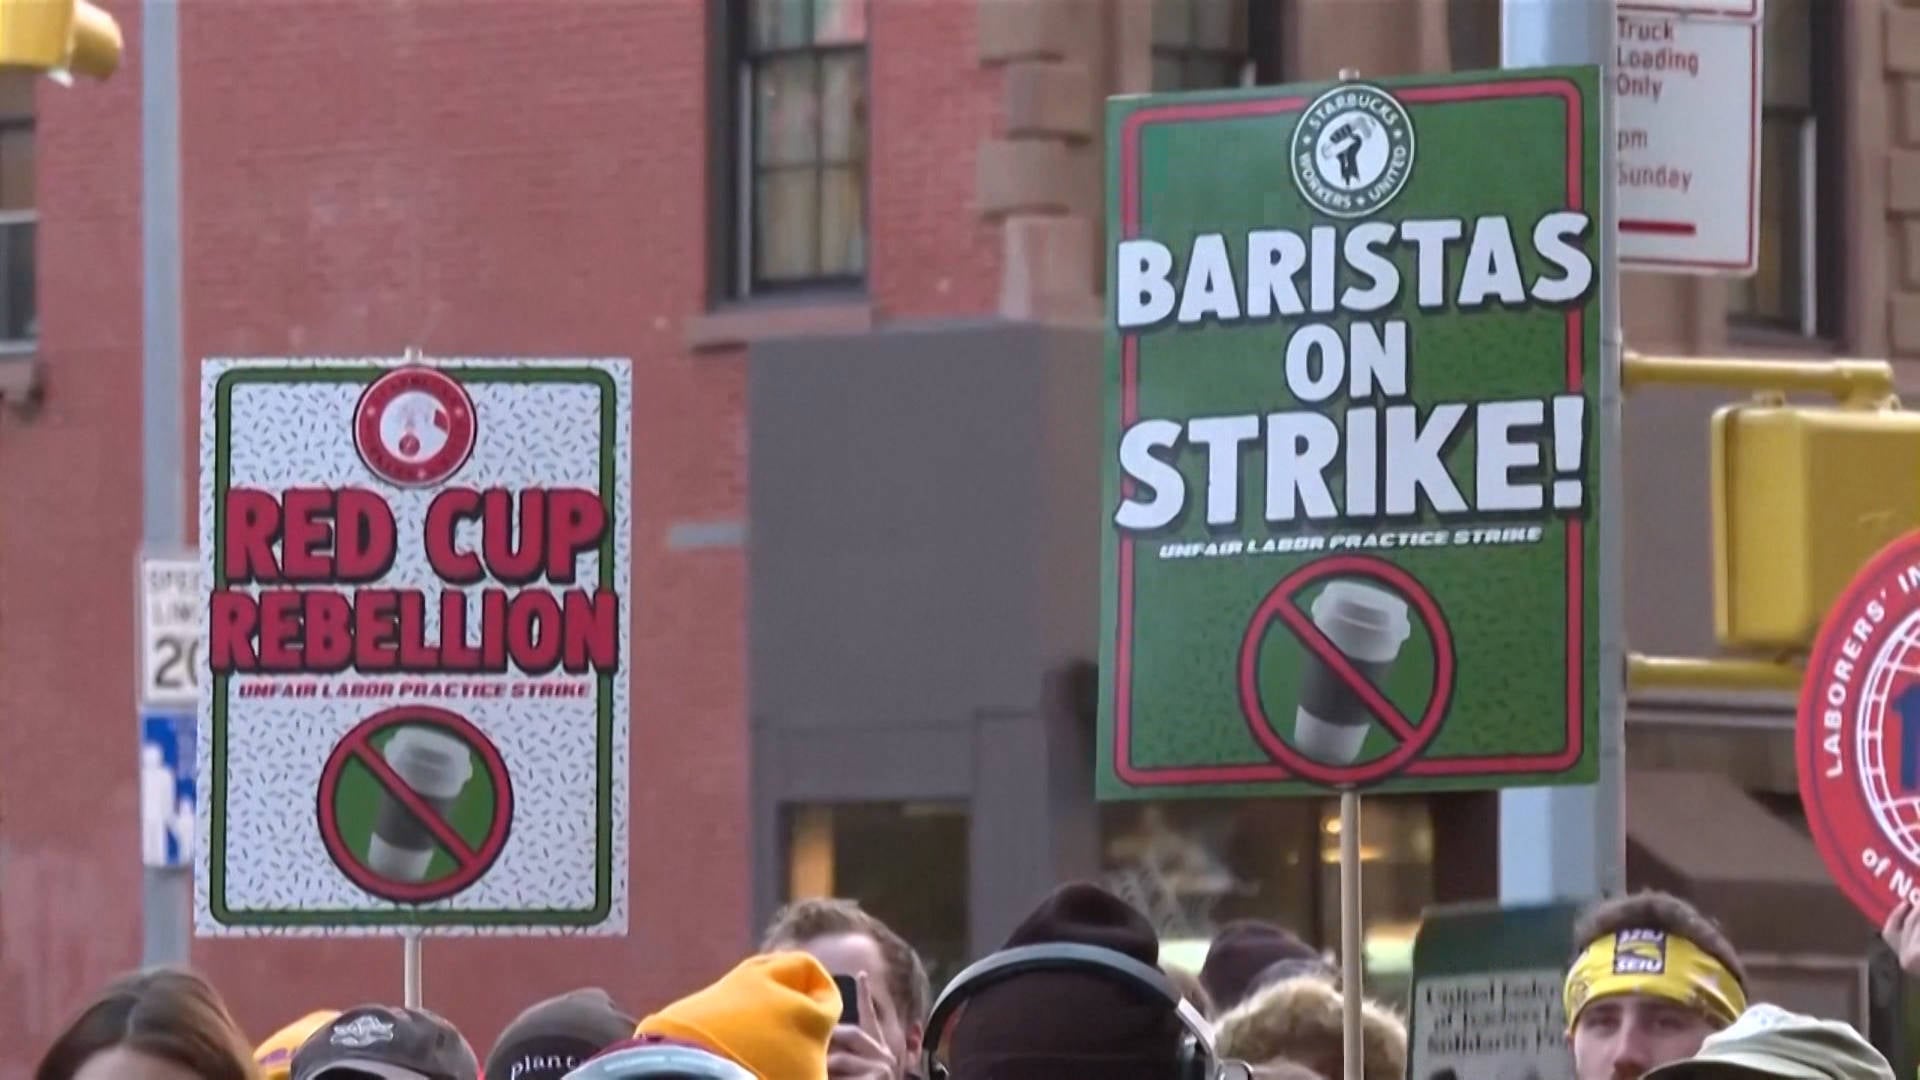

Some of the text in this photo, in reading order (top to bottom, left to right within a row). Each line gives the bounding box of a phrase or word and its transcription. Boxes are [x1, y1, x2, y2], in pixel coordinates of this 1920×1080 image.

[1617, 16, 1674, 41] Truck
[1617, 47, 1699, 77] Loading
[1617, 73, 1662, 102] Only
[1308, 92, 1400, 130] STARBUCKS
[1618, 130, 1647, 151] pm
[1368, 145, 1407, 201] UNITED
[1617, 163, 1692, 195] Sunday
[1116, 211, 1594, 327] BARISTAS
[1284, 320, 1407, 402] ON
[1114, 395, 1586, 529] STRIKE!
[226, 487, 608, 584] RED CUP
[1158, 526, 1543, 559] UNFAIR LABOR PRACTICE STRIKE
[210, 588, 619, 675] REBELLION
[238, 682, 590, 699] UNFAIR LABOR PRACTICE STRIKE
[1861, 847, 1892, 878] of
[1616, 957, 1663, 972] SEIU
